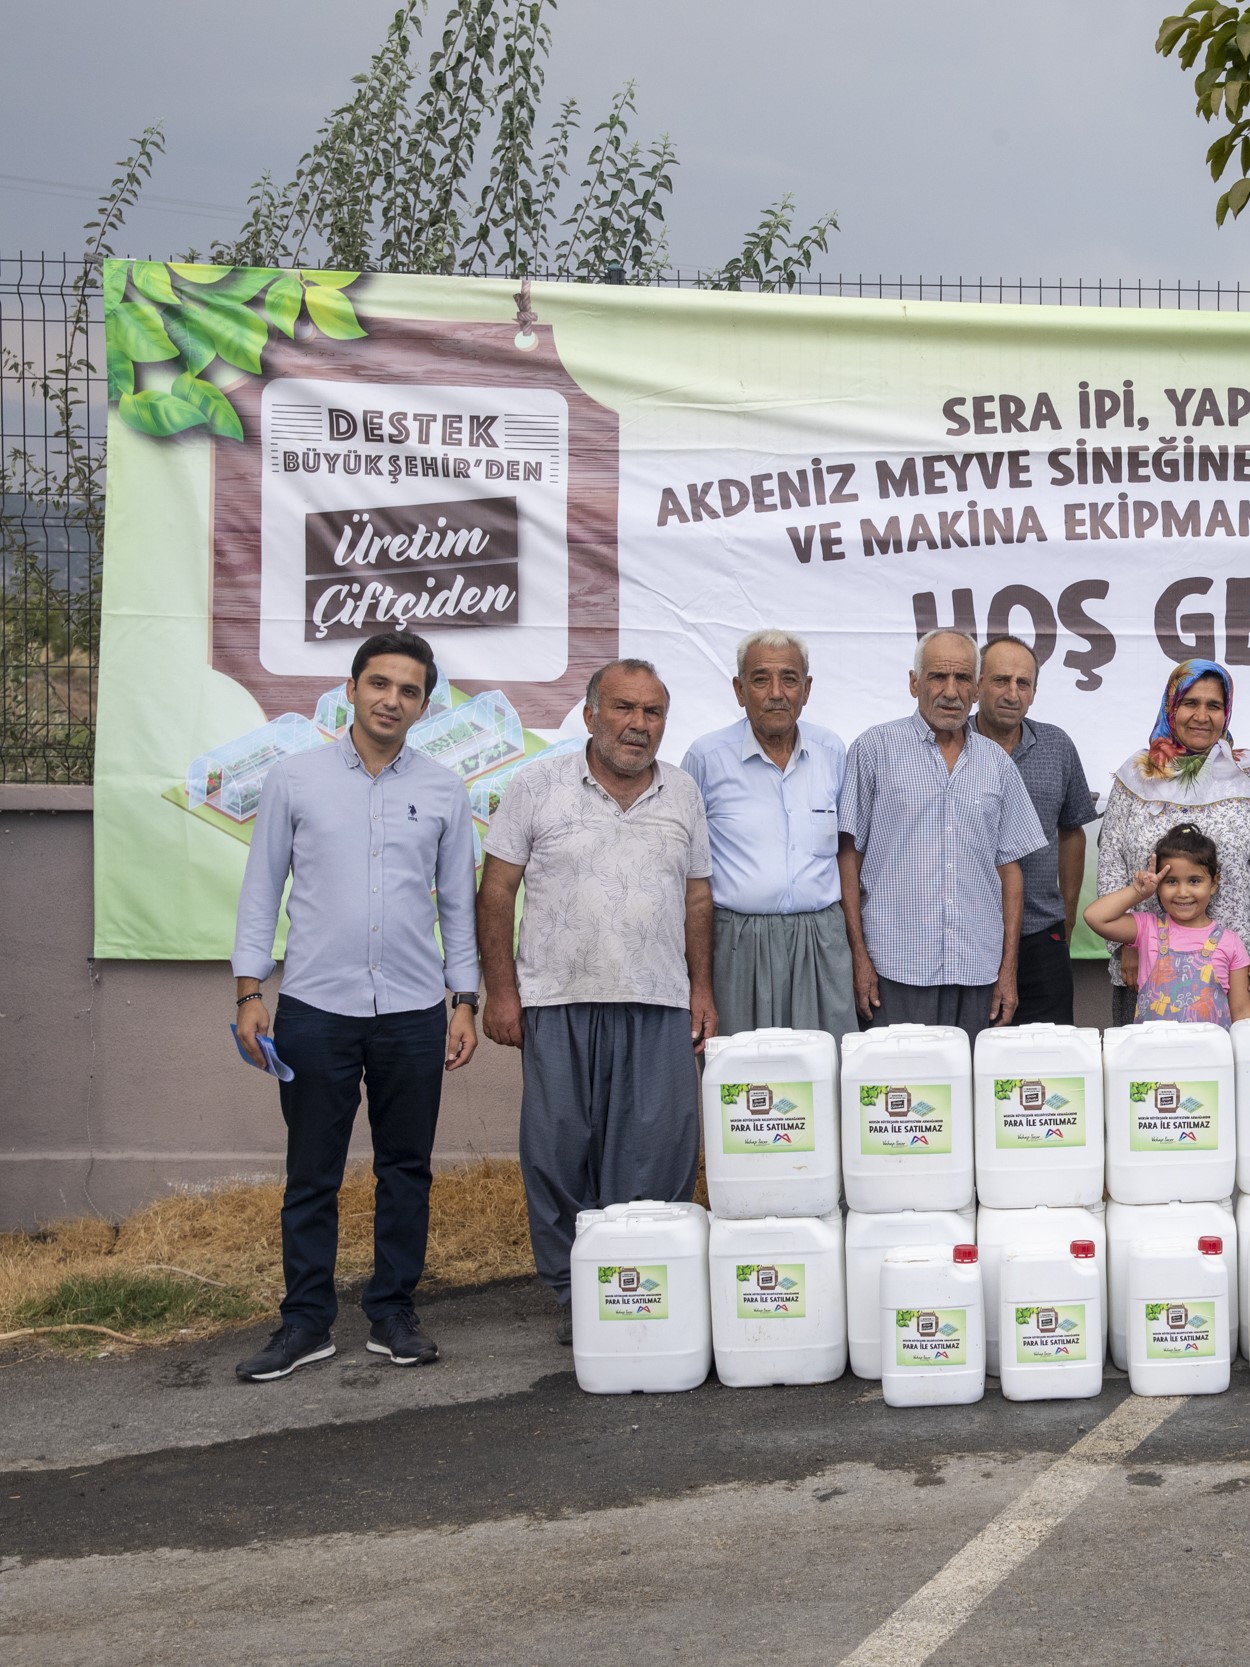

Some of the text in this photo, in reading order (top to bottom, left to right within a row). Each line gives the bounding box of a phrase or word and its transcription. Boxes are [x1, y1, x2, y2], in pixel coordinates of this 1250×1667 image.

[327, 408, 499, 448] DESTEK
[942, 392, 1063, 437] SERA
[1078, 379, 1150, 432] İPİ,
[283, 447, 543, 484] BÜYÜKŞEHİR'DEN
[656, 457, 859, 527] AKDENİZ
[876, 449, 1033, 500] MEYVE
[333, 513, 490, 566] Üretim
[785, 521, 847, 564] VE
[862, 500, 1049, 558] MAKİNA
[312, 574, 516, 639] Çiftçiden
[754, 1123, 764, 1131] İLE
[892, 1124, 902, 1133] İLE
[1026, 1118, 1036, 1126] İLE
[1039, 1118, 1076, 1126] SATILMAZ
[1161, 1121, 1170, 1129] İLE
